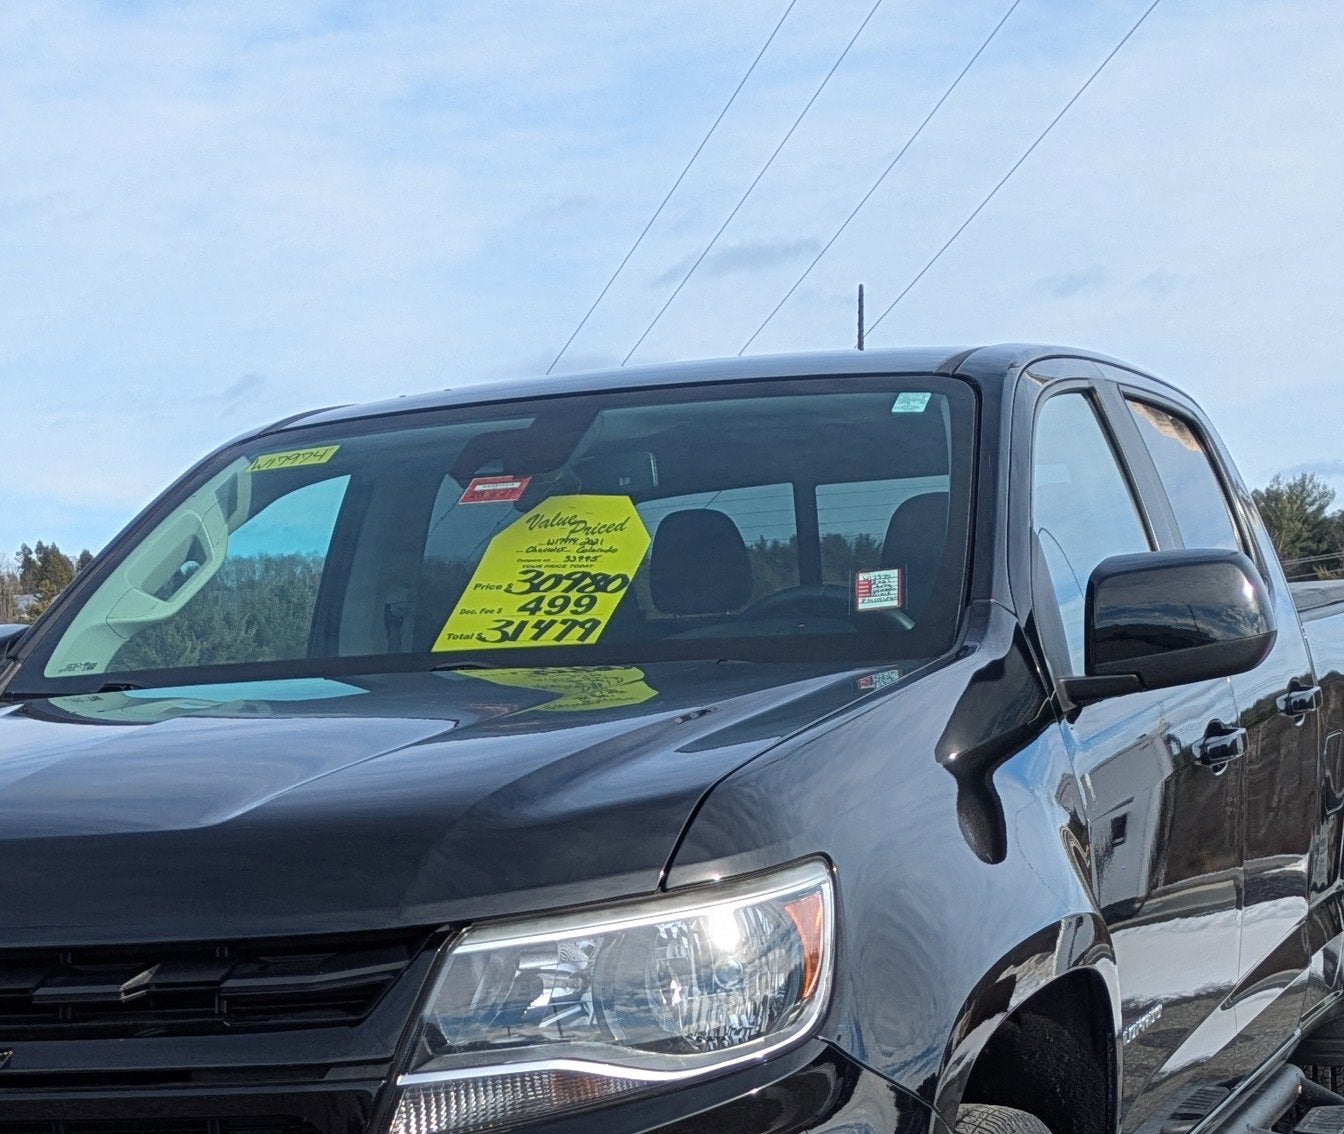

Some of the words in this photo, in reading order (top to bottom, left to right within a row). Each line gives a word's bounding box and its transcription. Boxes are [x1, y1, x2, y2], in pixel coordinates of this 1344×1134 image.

[526, 512, 577, 531] Value
[567, 517, 630, 538] Priced
[473, 583, 502, 591] Price
[505, 569, 630, 595] 30980
[517, 594, 597, 616] 499
[447, 633, 473, 641] Total
[478, 618, 602, 643] 31479
